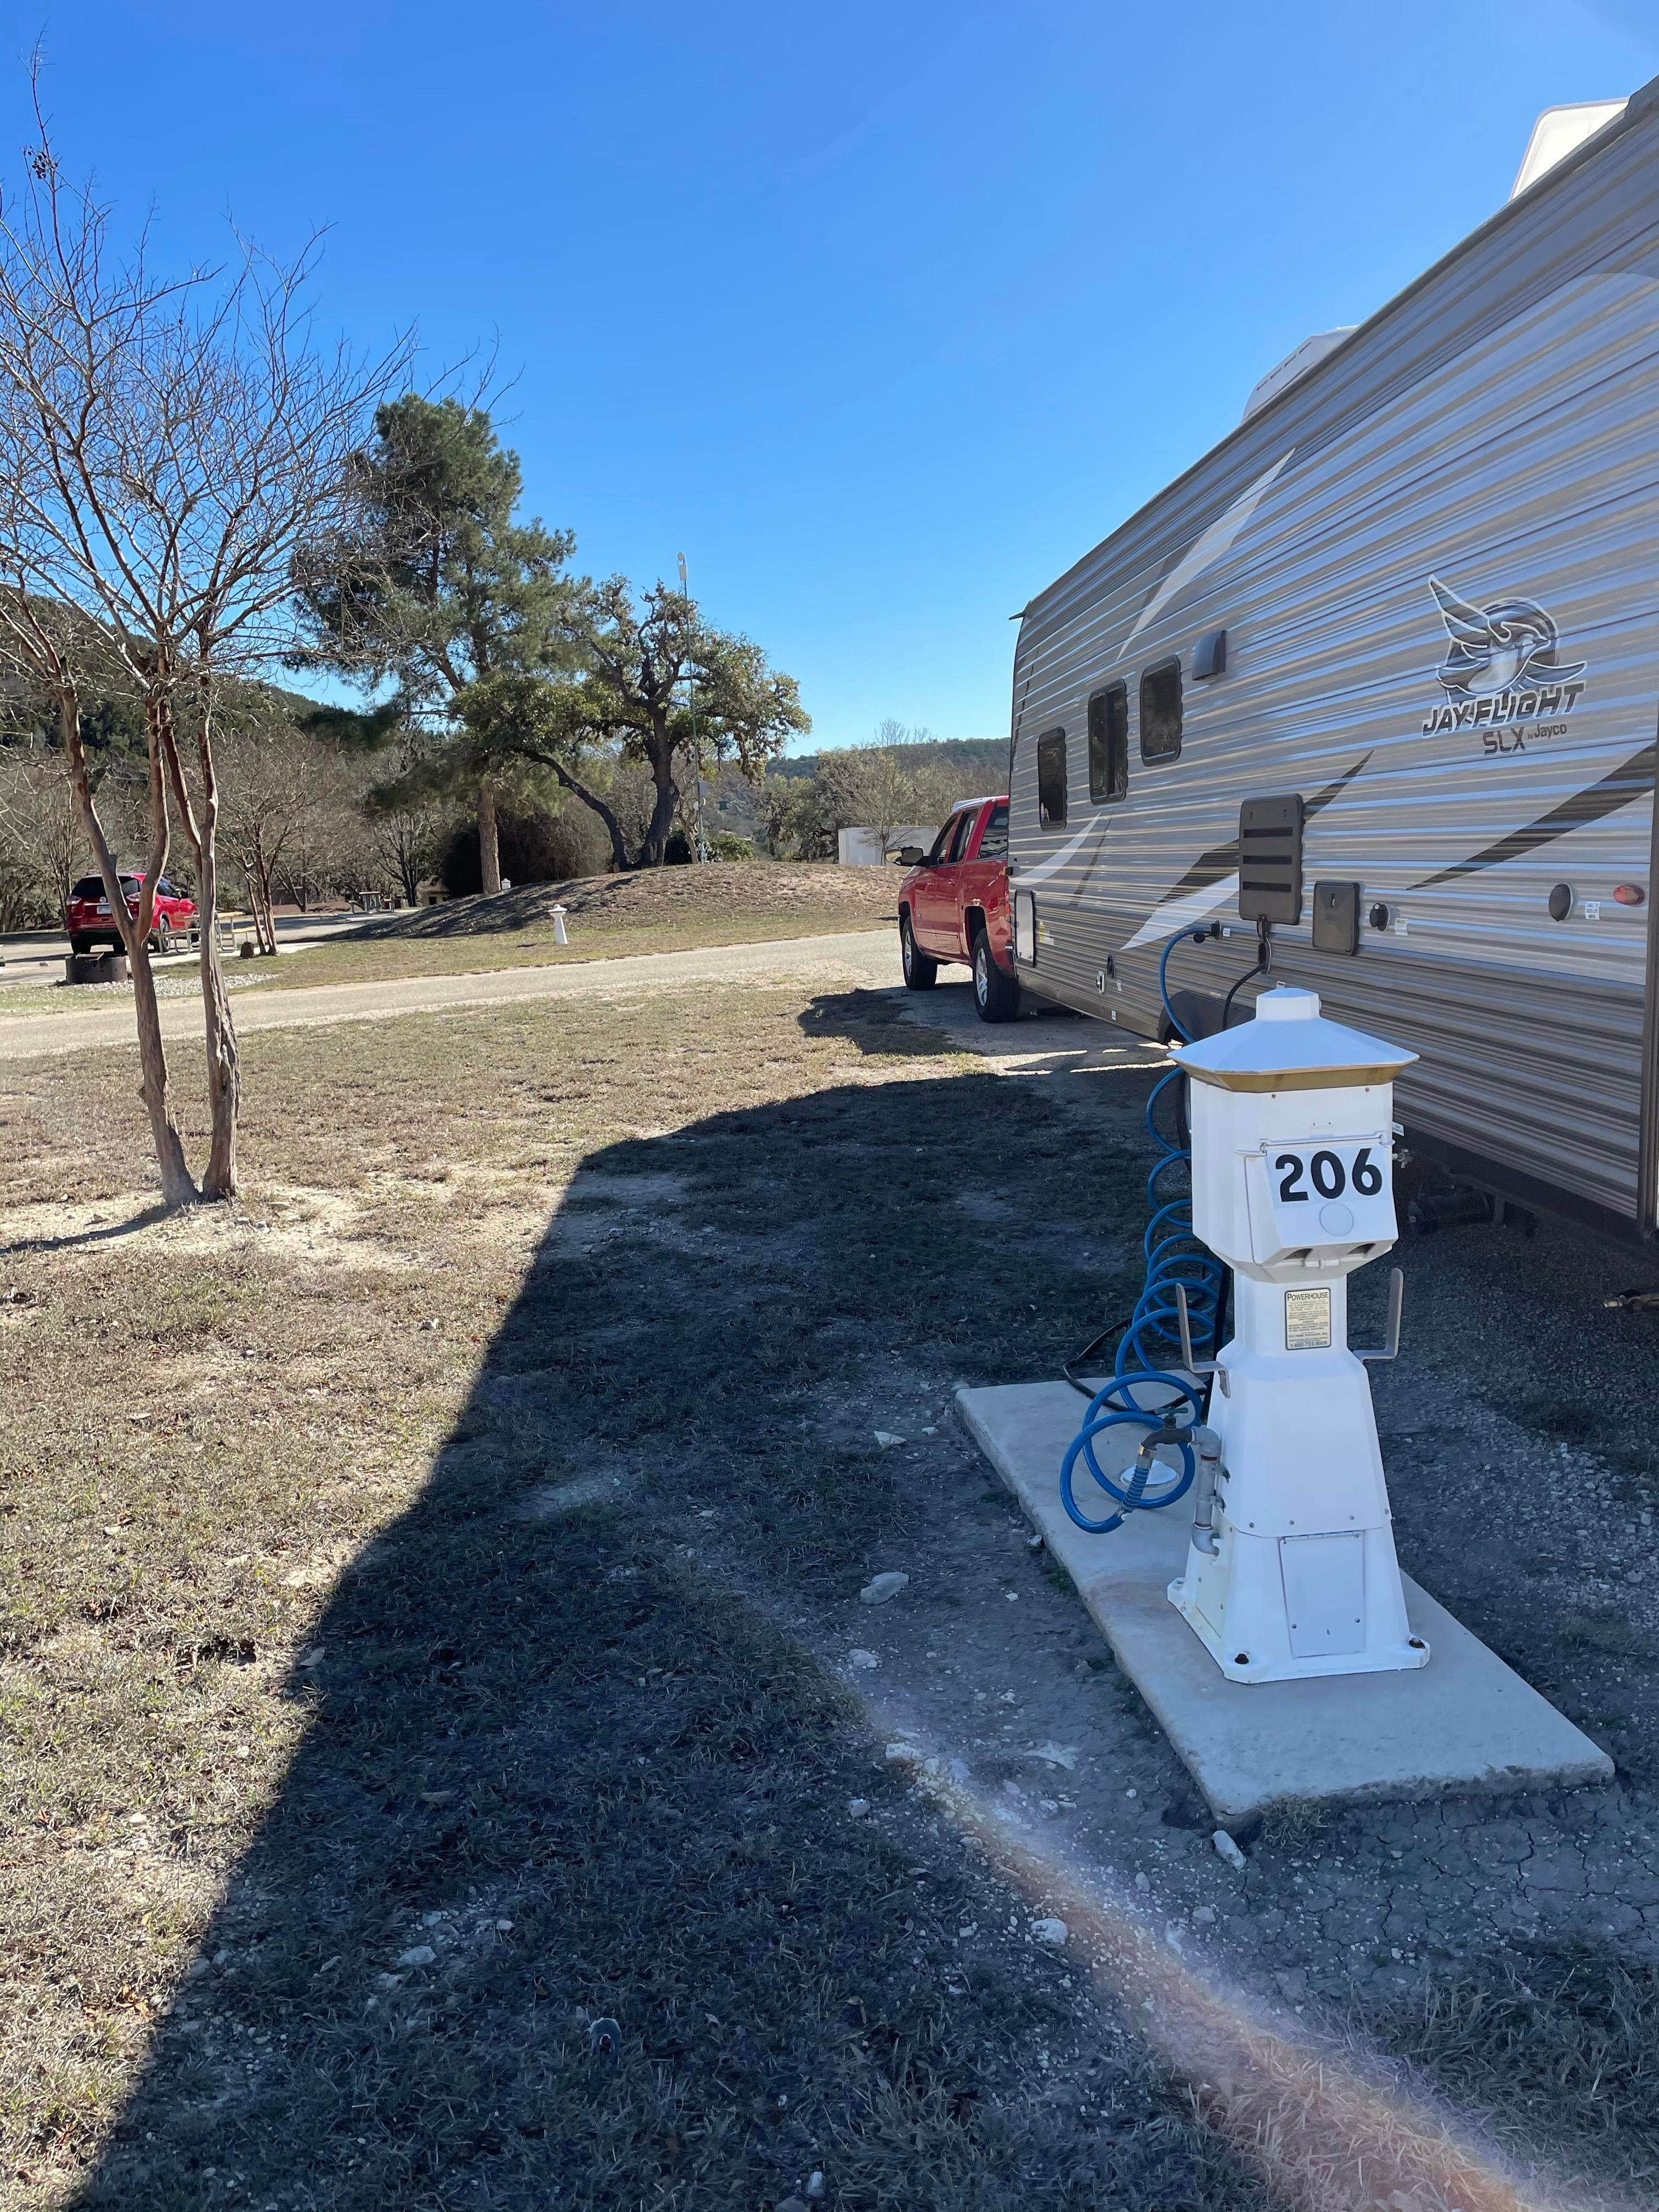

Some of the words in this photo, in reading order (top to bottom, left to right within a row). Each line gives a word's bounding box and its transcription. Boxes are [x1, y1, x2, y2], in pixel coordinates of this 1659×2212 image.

[1482, 726, 1526, 755] SLX
[1534, 724, 1567, 740] Jayco
[1276, 1148, 1383, 1202] 206
